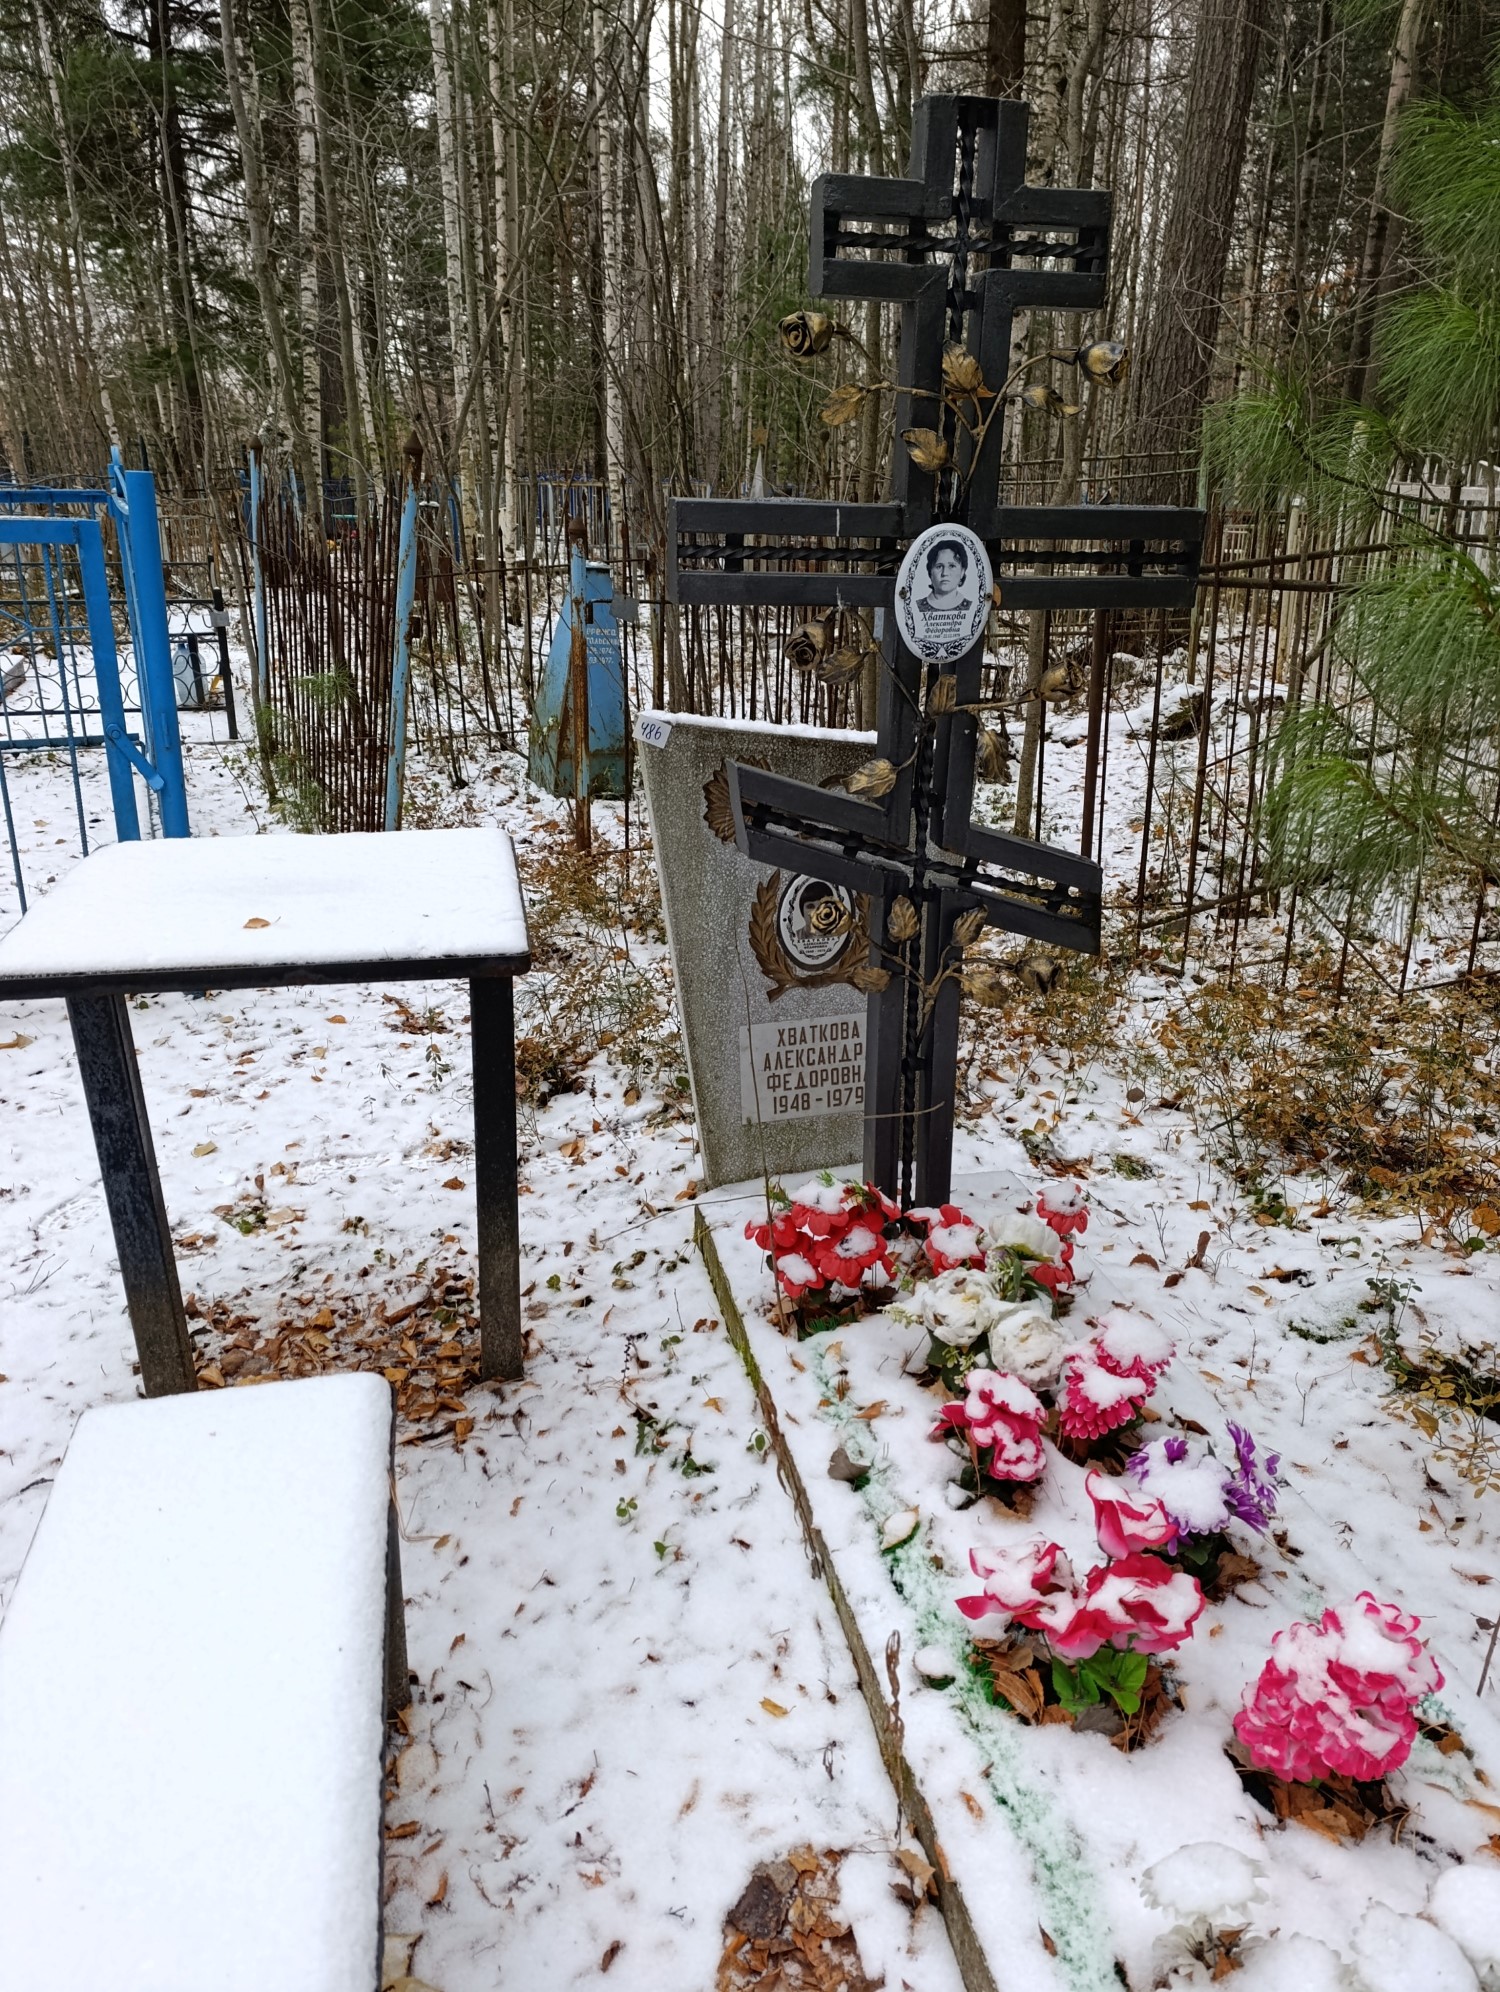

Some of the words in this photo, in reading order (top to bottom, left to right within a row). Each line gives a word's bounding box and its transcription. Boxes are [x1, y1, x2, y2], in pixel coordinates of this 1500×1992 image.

[921, 611, 967, 621] Хваткова
[924, 620, 962, 628] Александра
[641, 722, 662, 740] 486
[777, 1021, 860, 1047] ХВАТКОВА
[763, 1042, 863, 1072] АЛЕКСАНДР
[767, 1065, 865, 1092] ФЕДОРОВН
